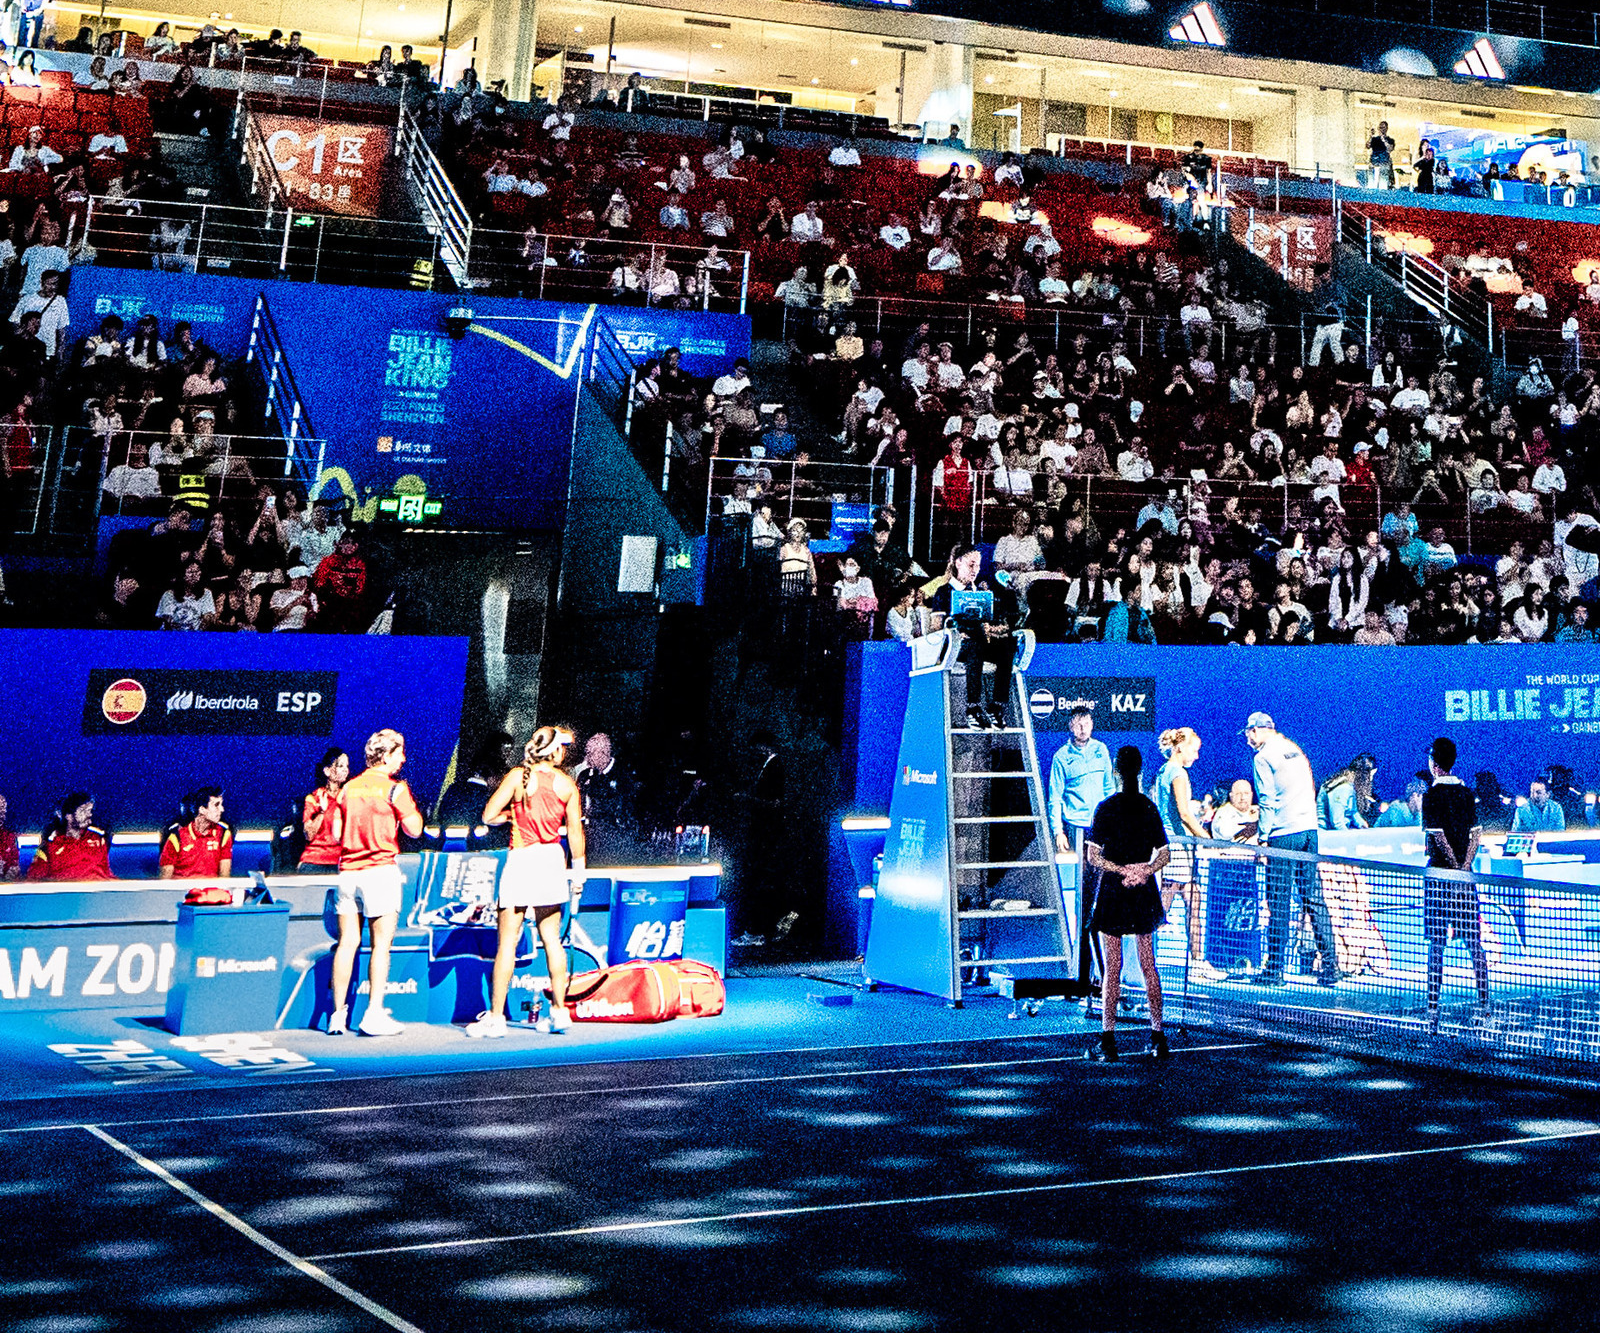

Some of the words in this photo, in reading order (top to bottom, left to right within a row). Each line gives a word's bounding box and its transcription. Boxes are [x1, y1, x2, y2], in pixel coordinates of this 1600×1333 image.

[333, 166, 362, 178] Area
[1525, 674, 1544, 685] THE
[1546, 674, 1579, 685] WORLD
[1581, 673, 1600, 684] CUP
[195, 694, 259, 711] Iberdrola
[277, 691, 322, 712] ESP
[1111, 693, 1146, 712] KAZ
[1445, 688, 1542, 721] BILLIE
[911, 769, 938, 785] Microsoft
[217, 956, 277, 973] Microsoft
